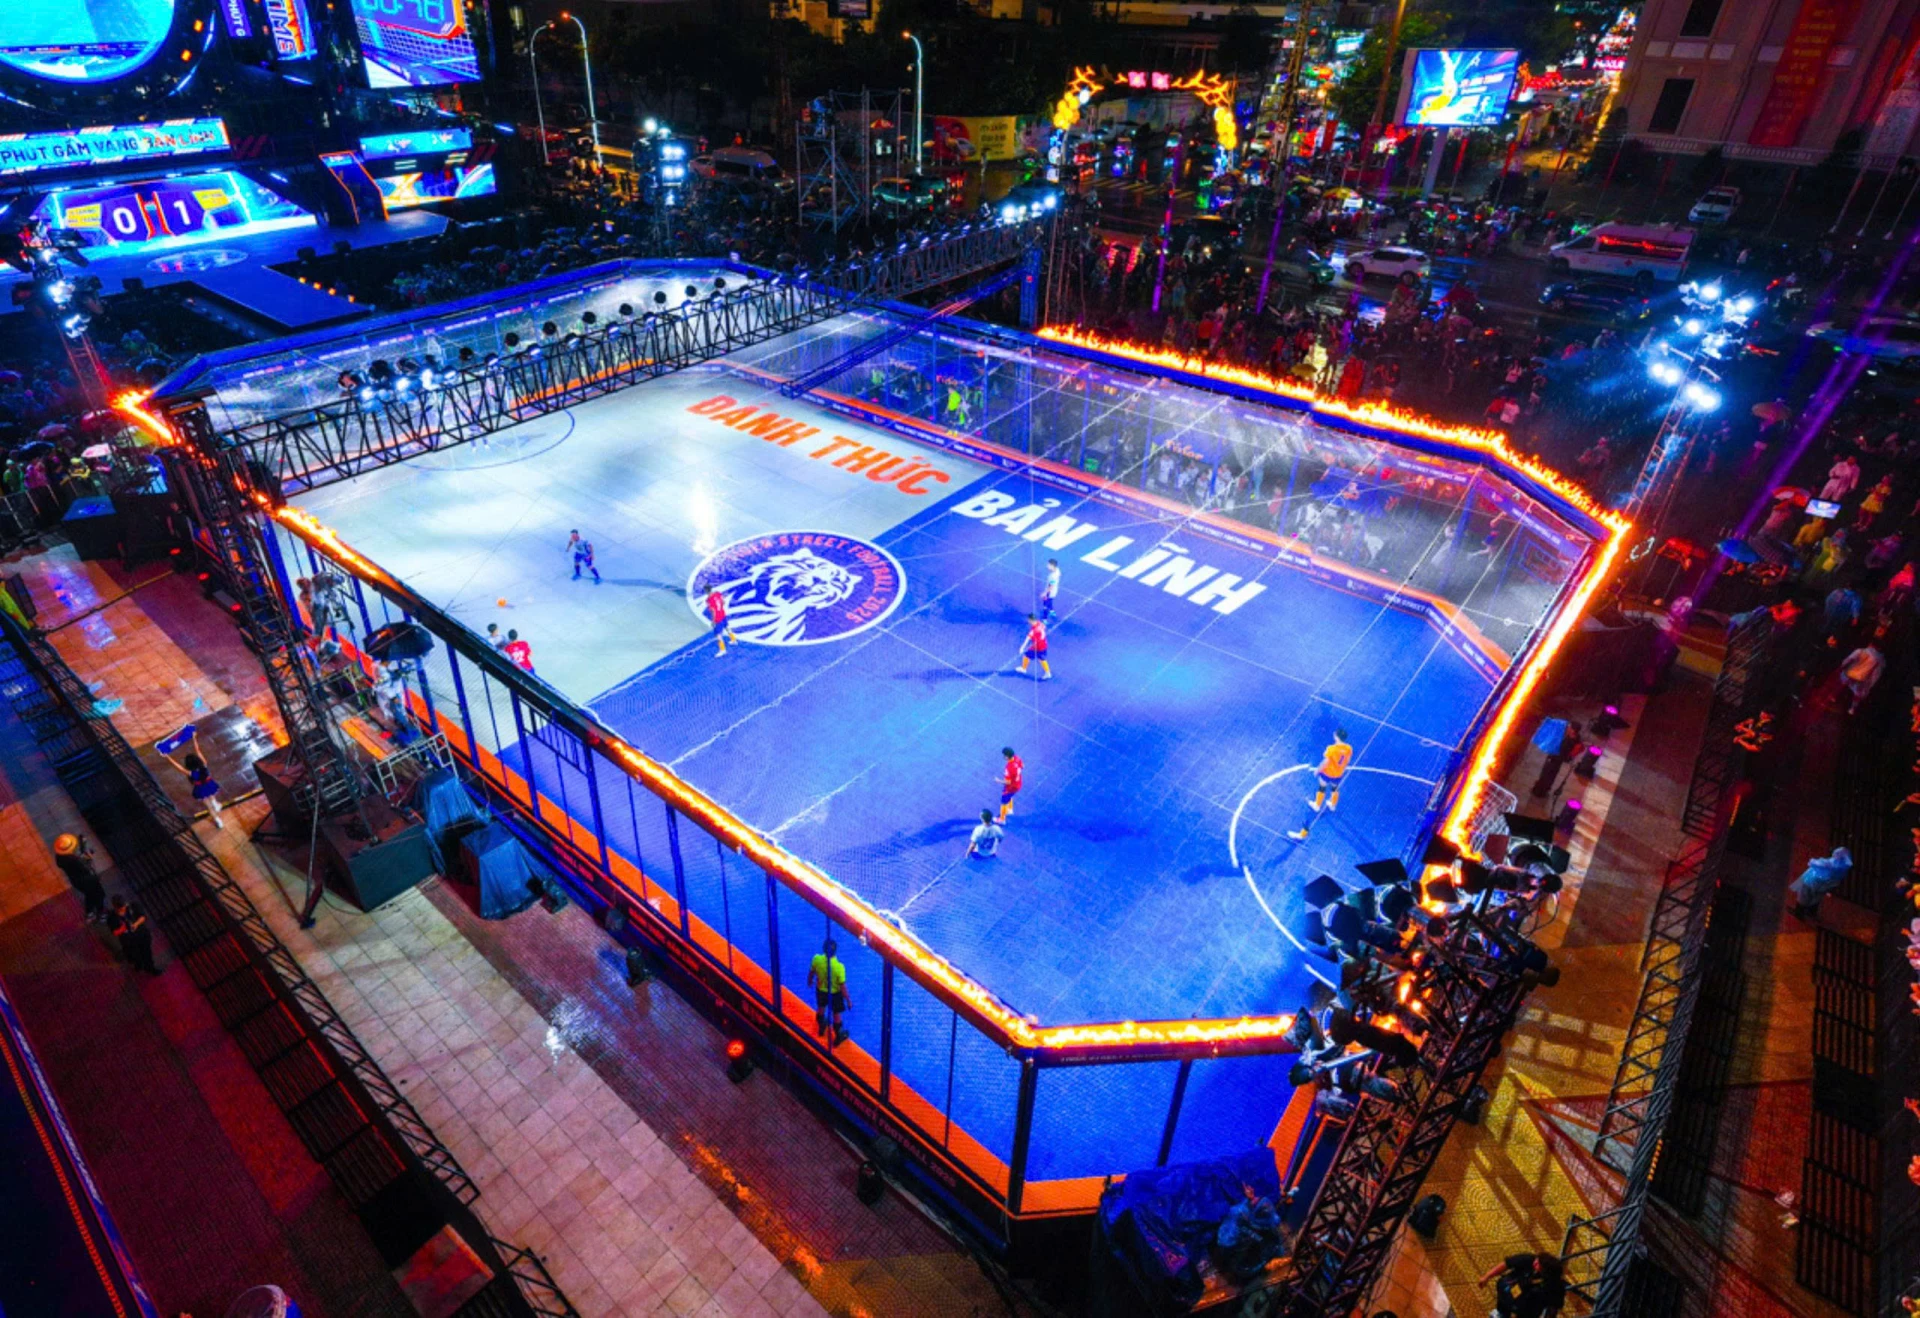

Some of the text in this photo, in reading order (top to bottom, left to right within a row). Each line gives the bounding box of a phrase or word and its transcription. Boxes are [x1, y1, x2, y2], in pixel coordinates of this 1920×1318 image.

[112, 207, 137, 234] 0
[173, 200, 191, 226] 1
[808, 435, 950, 495] THỨC
[950, 489, 1099, 551] BẢN
[1080, 536, 1267, 615] LĨNH
